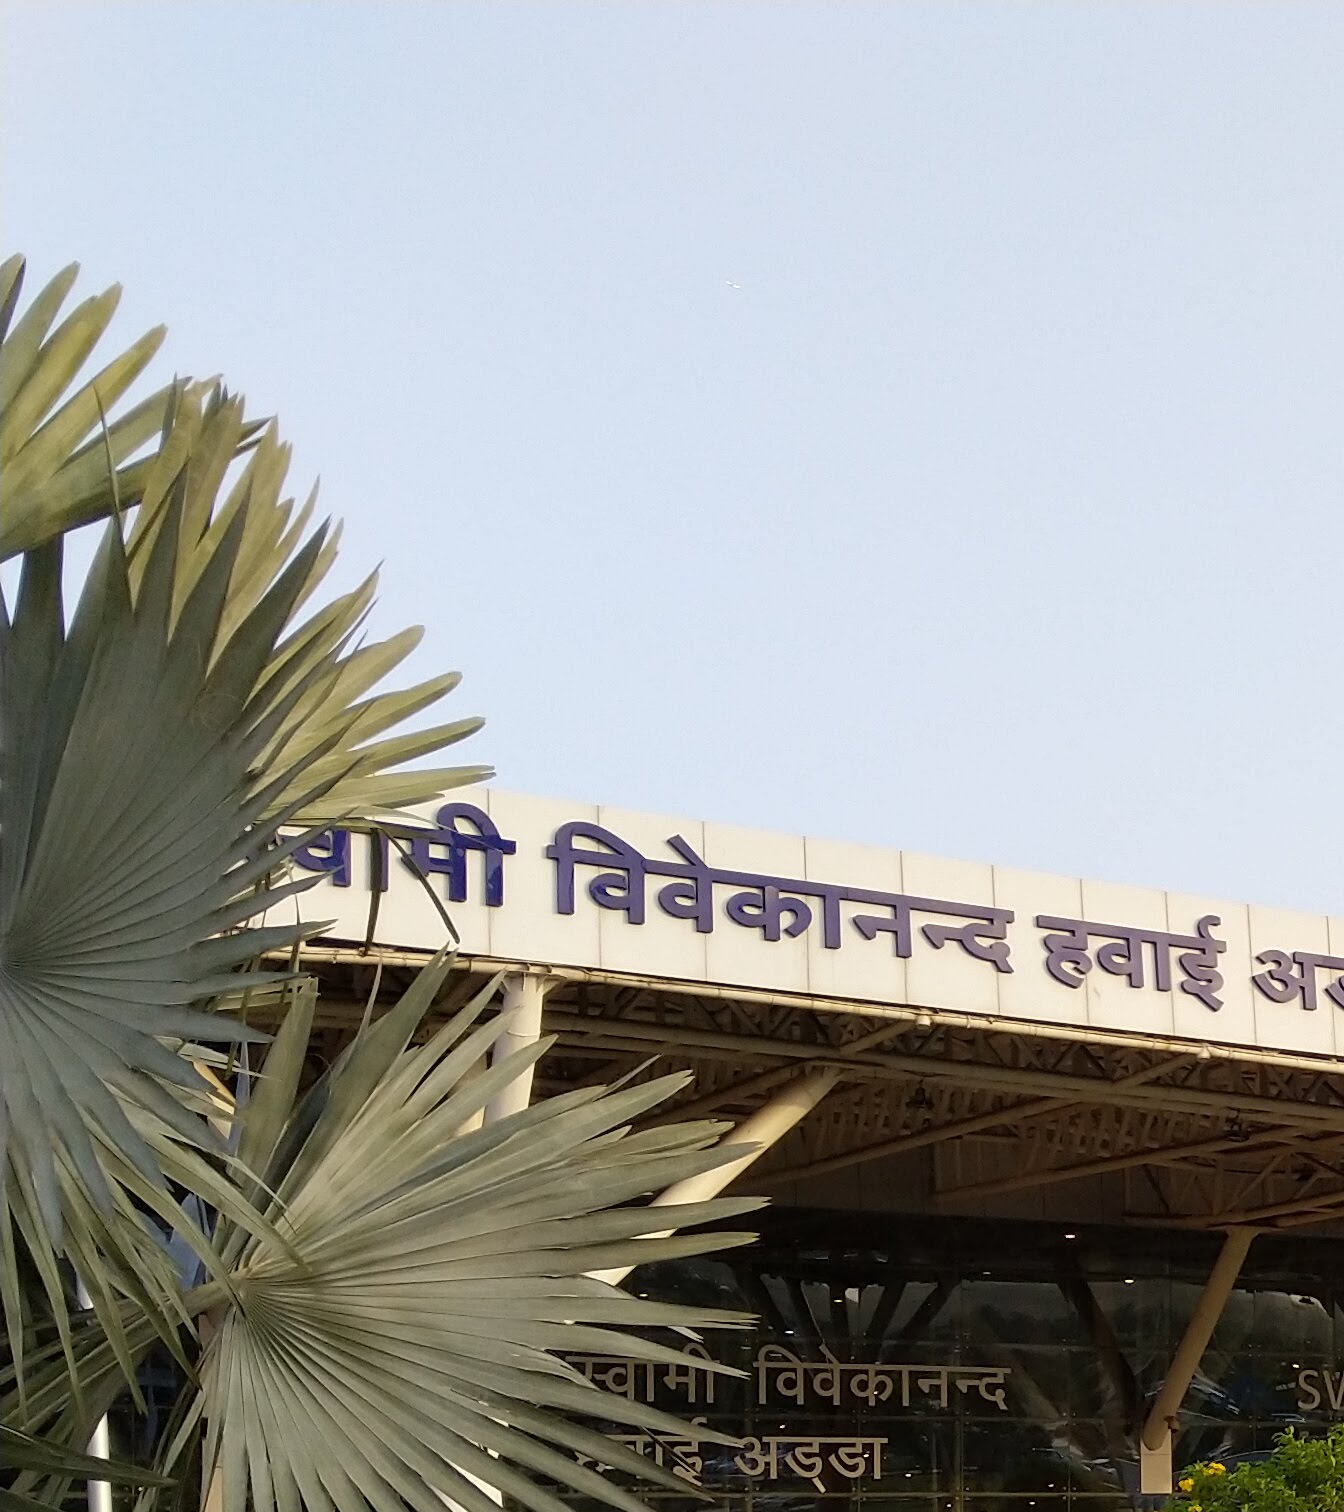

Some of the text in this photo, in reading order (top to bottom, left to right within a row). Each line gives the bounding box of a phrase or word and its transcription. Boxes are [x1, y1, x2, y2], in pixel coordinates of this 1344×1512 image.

[272, 802, 517, 908] वामी
[547, 821, 1015, 974] विवेकानन्द
[1035, 914, 1227, 1012] हवाई
[753, 1344, 1011, 1411] विवेकानन्द
[734, 1435, 889, 1494] अड्डा
